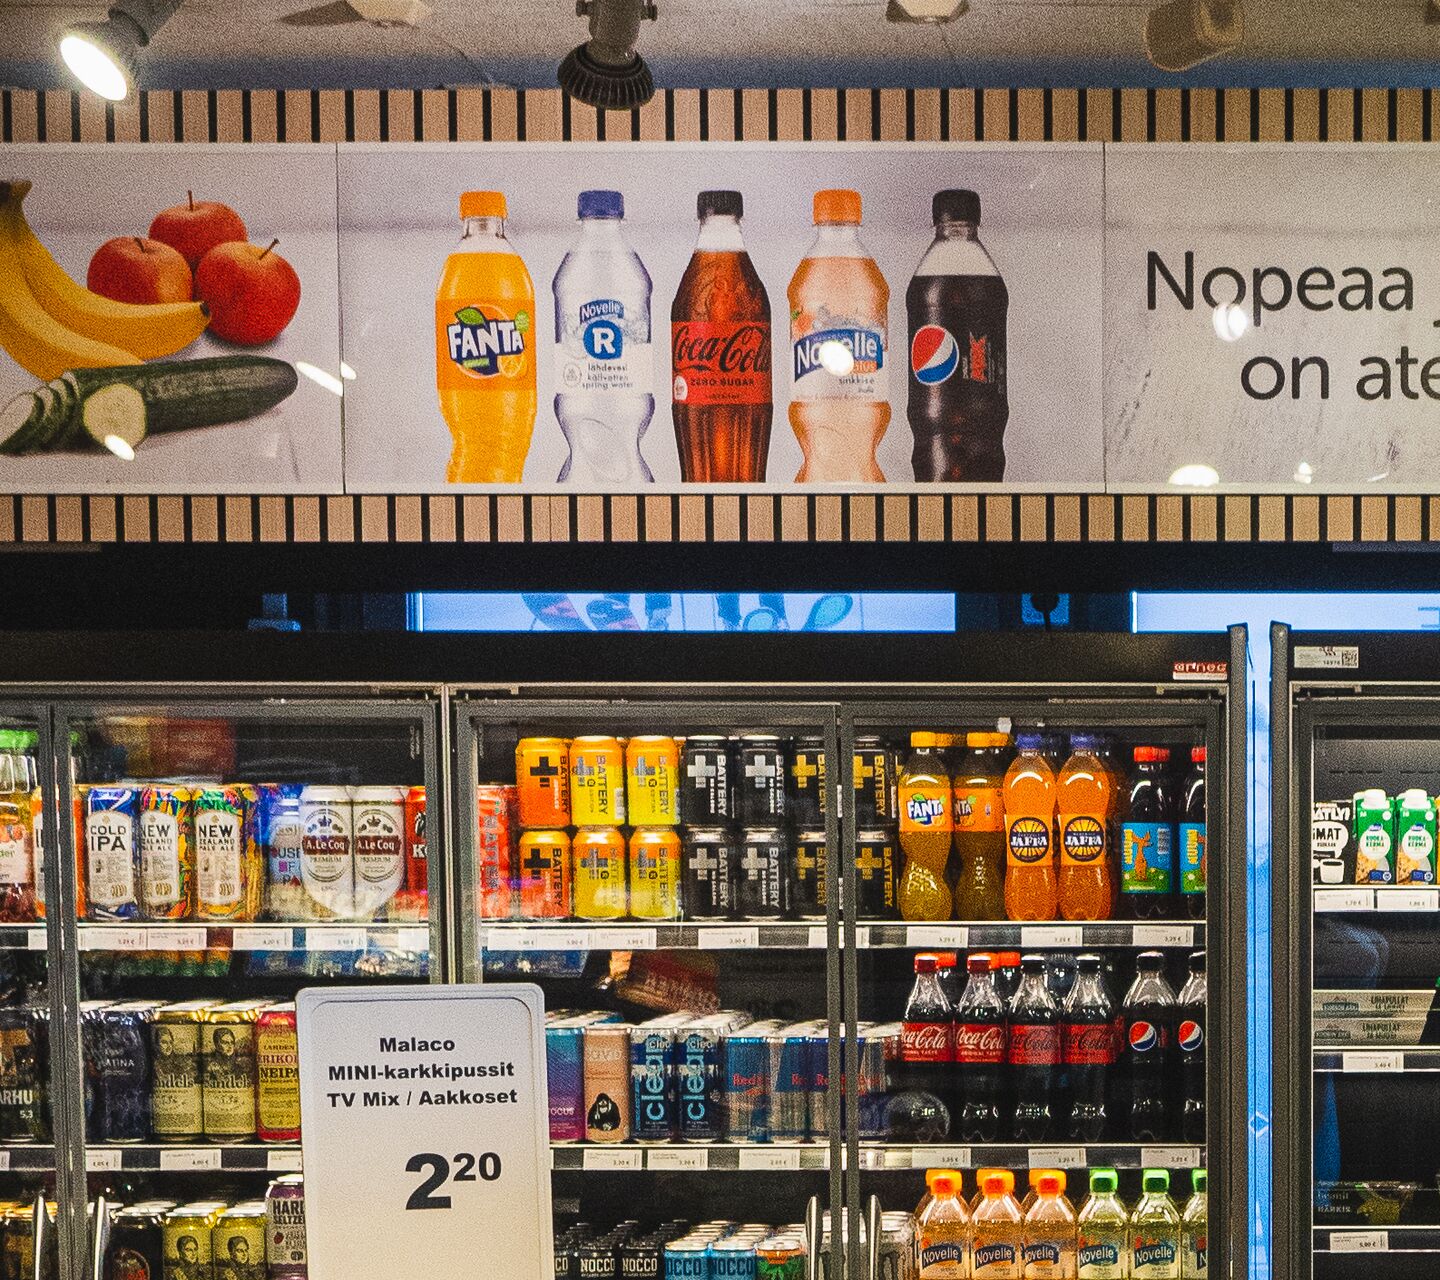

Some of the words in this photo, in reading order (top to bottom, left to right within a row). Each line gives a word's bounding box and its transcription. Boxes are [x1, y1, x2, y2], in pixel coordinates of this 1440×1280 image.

[1147, 250, 1413, 325] Nopeaa
[581, 302, 621, 319] Novelle
[448, 324, 524, 360] FANTA
[796, 334, 878, 375] Noelle
[1241, 347, 1329, 400] on
[717, 754, 728, 816] BATTERY
[874, 754, 886, 816] BATTERY
[90, 824, 127, 836] COLD
[91, 836, 126, 851] IPA
[1010, 834, 1048, 847] JAFFA
[1064, 835, 1103, 847] JAFFA
[552, 847, 564, 908] BATTERY
[769, 847, 780, 908] BATTERY
[379, 1037, 455, 1053] Malaco
[328, 1062, 514, 1082] MINI-karkkipussit
[327, 1092, 356, 1108] TV
[363, 1091, 400, 1107] Mix
[418, 1089, 518, 1105] Aakkoset
[580, 1257, 616, 1273] NOCCO
[622, 1257, 658, 1273] NOCCO
[922, 1246, 959, 1266] Novelle
[975, 1246, 1013, 1266] Novelle
[1135, 1246, 1173, 1265] Novelle
